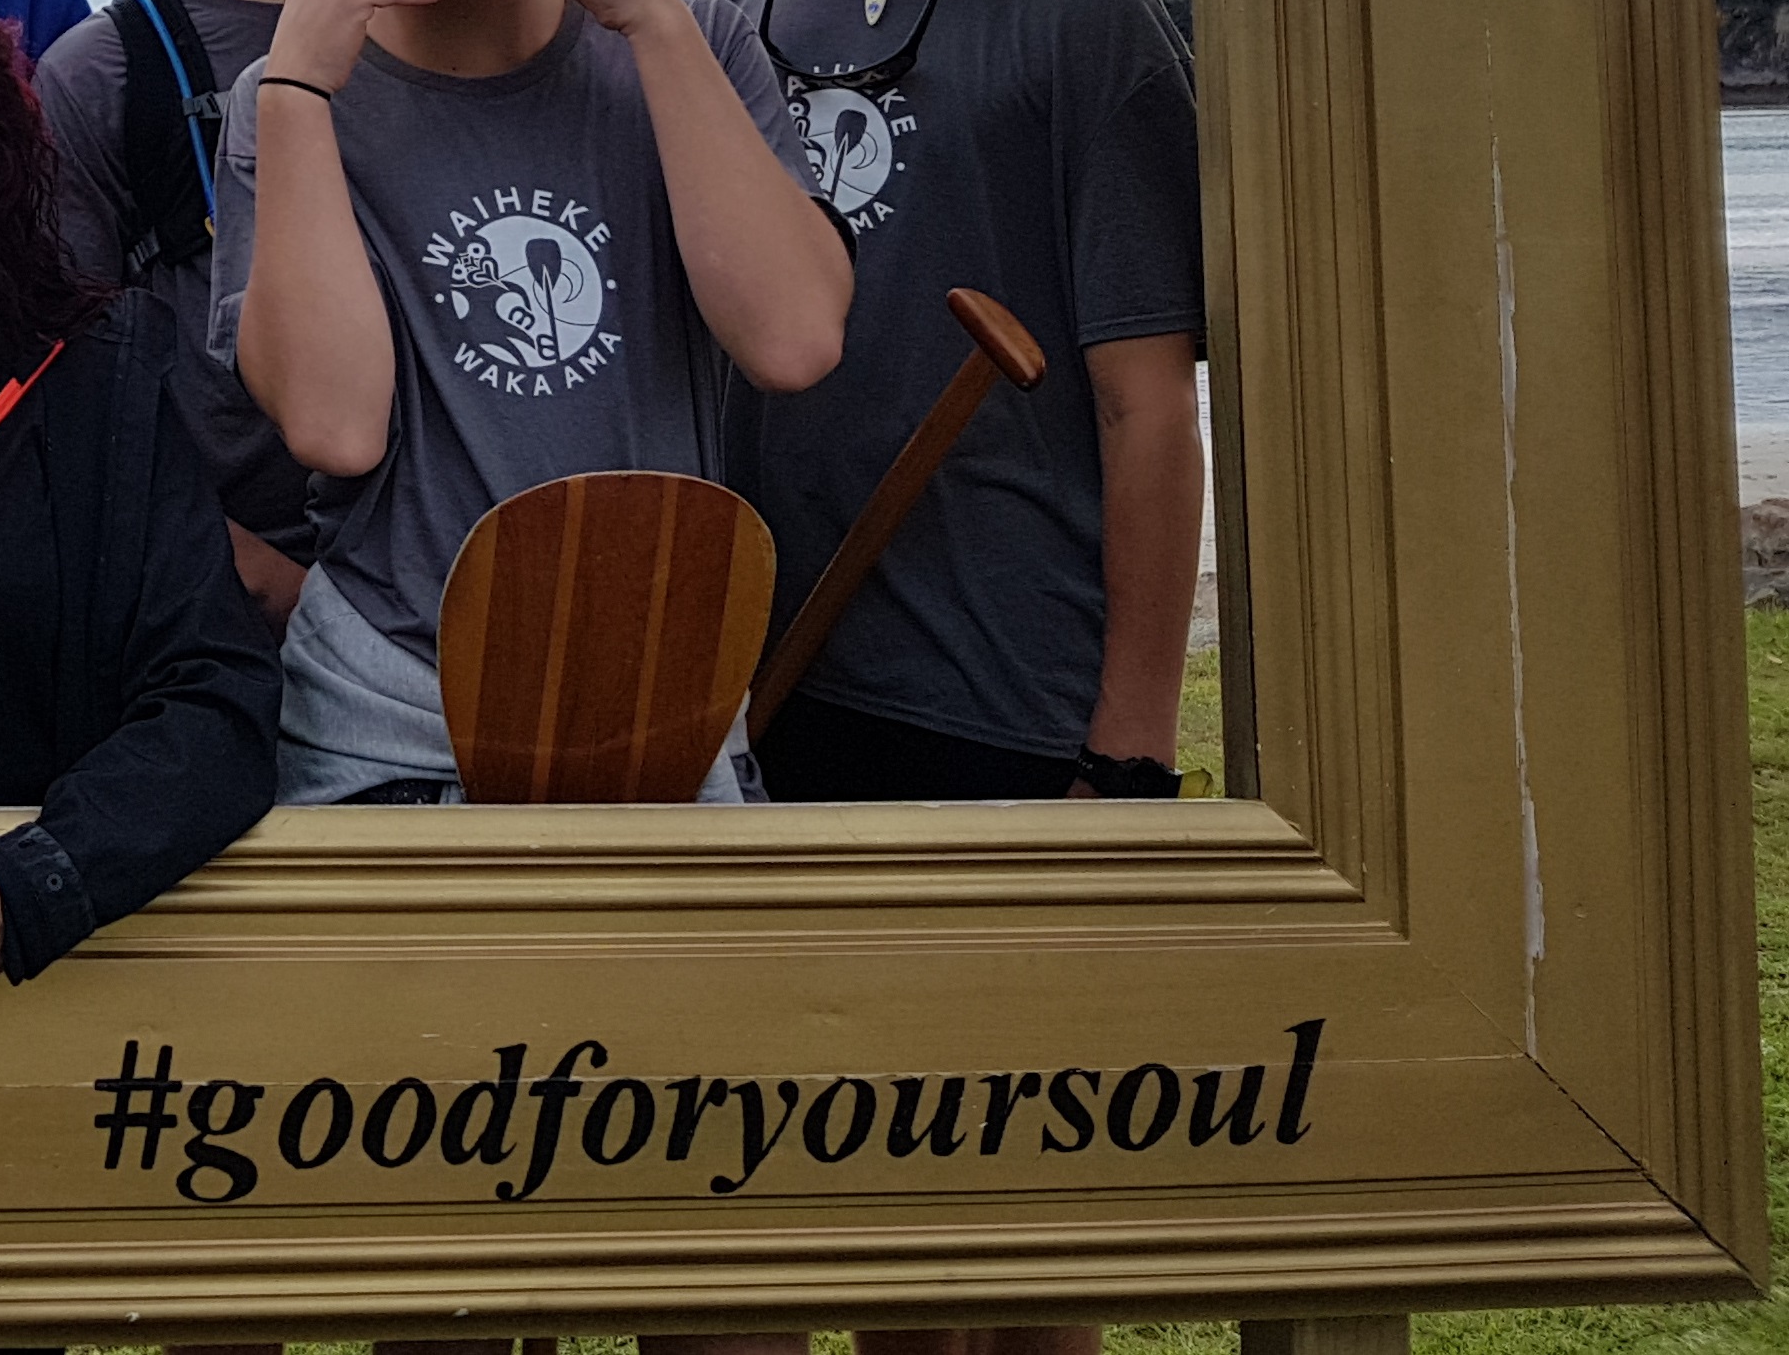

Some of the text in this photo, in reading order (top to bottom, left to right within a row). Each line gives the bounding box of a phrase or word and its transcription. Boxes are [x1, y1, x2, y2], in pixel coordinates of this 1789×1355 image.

[421, 186, 612, 267] WAIHEKE
[453, 331, 623, 396] WAKA AMA
[94, 1018, 1327, 1204] #goodforyoursoul
